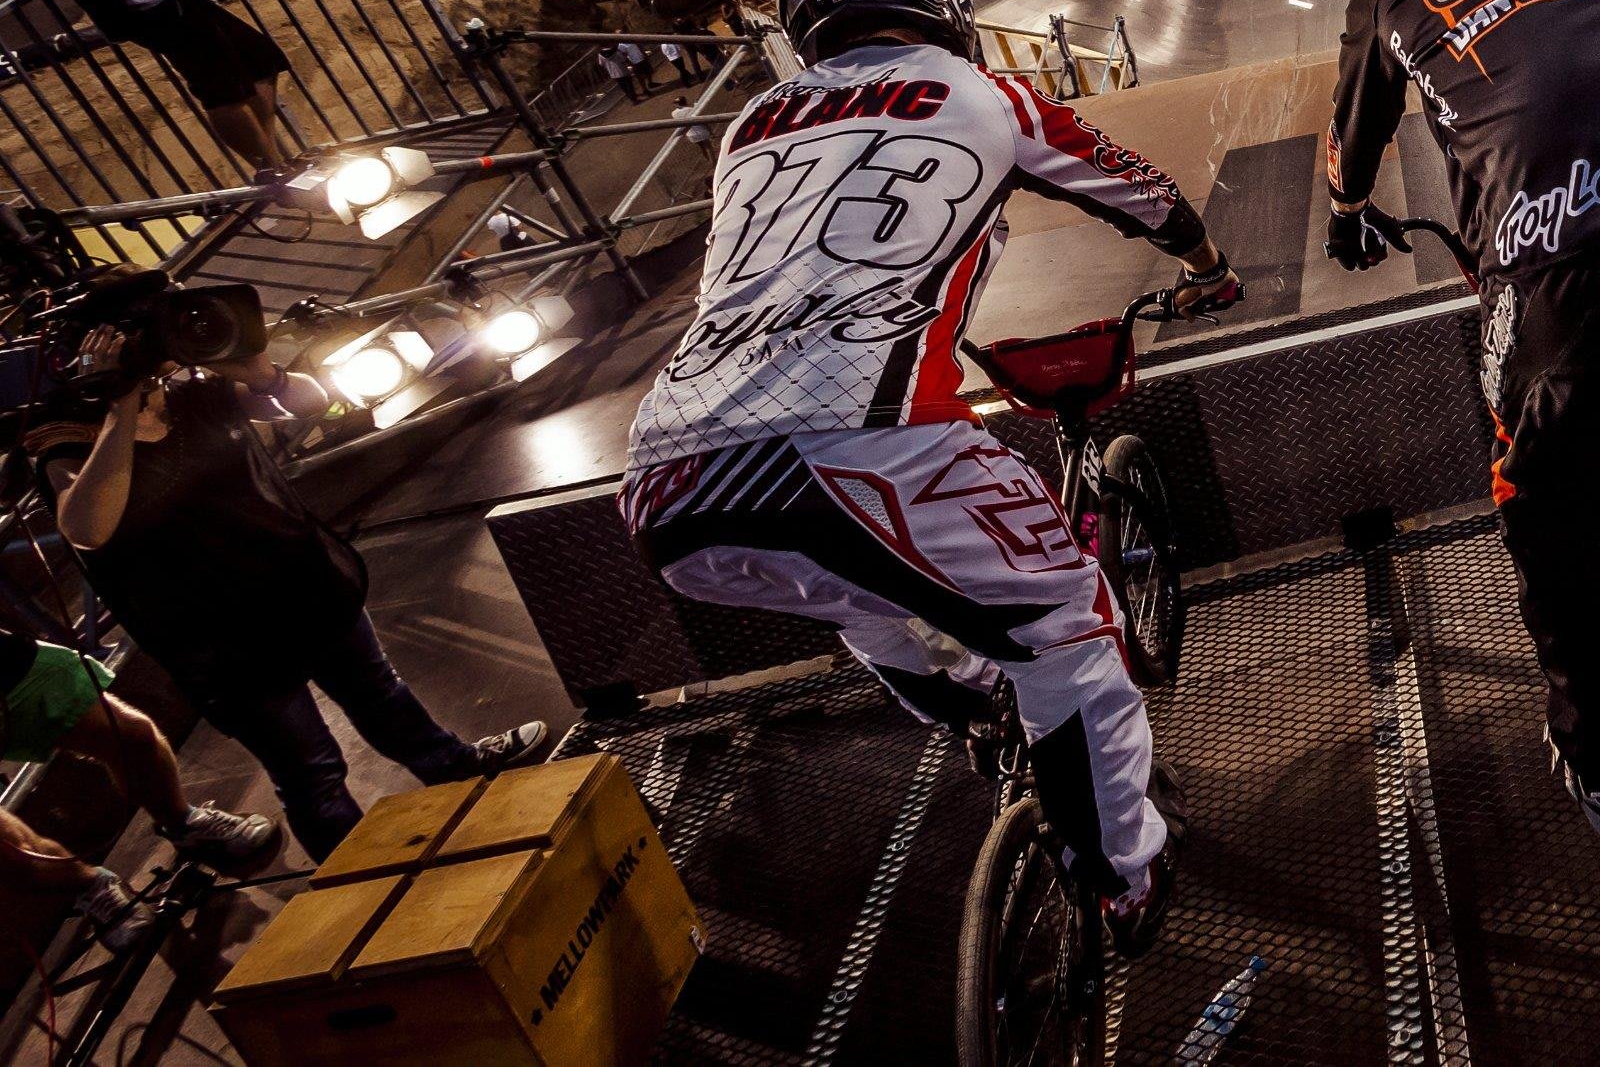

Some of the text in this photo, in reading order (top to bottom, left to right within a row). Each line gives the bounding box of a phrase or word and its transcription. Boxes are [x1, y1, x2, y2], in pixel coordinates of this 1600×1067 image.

[727, 79, 951, 156] BLANC
[1496, 190, 1567, 265] Troy
[658, 275, 943, 383] oyalty
[539, 844, 640, 1012] MELLOWPARK
